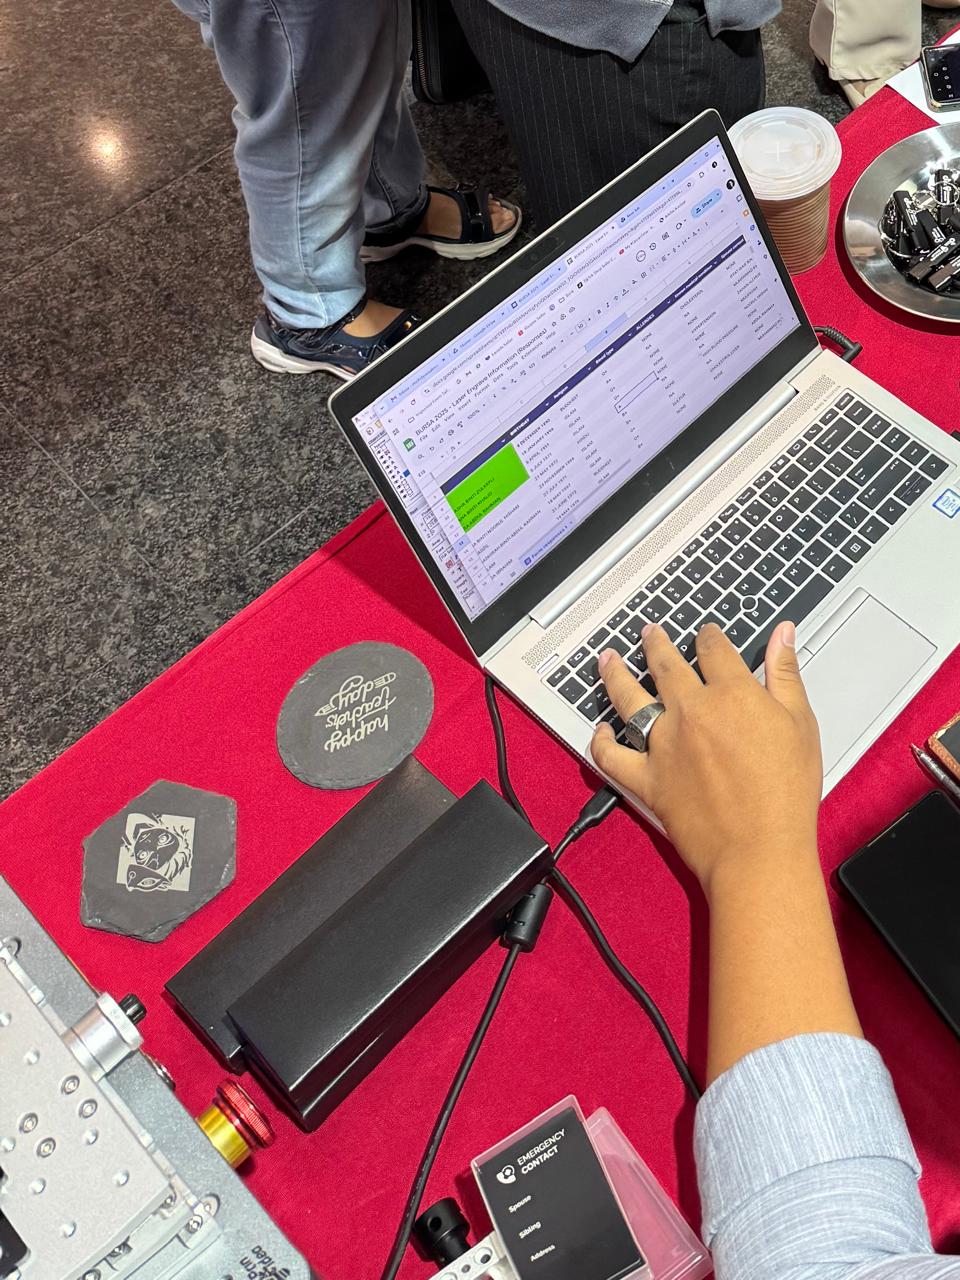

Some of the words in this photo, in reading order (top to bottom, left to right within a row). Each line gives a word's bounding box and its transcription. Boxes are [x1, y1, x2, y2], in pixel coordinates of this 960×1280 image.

[414, 417, 435, 437] BURSA
[432, 406, 449, 422] 2025
[450, 391, 467, 408] Laser
[465, 374, 489, 397] Engrave
[486, 350, 518, 379] Information
[515, 326, 549, 357] (Responses)
[324, 714, 389, 753] happy
[517, 1128, 566, 1166] EMERGENCY
[521, 1145, 559, 1175] CONTACT
[508, 1195, 532, 1213] Spouse
[518, 1220, 542, 1239] Sibling
[530, 1244, 556, 1262] Address
